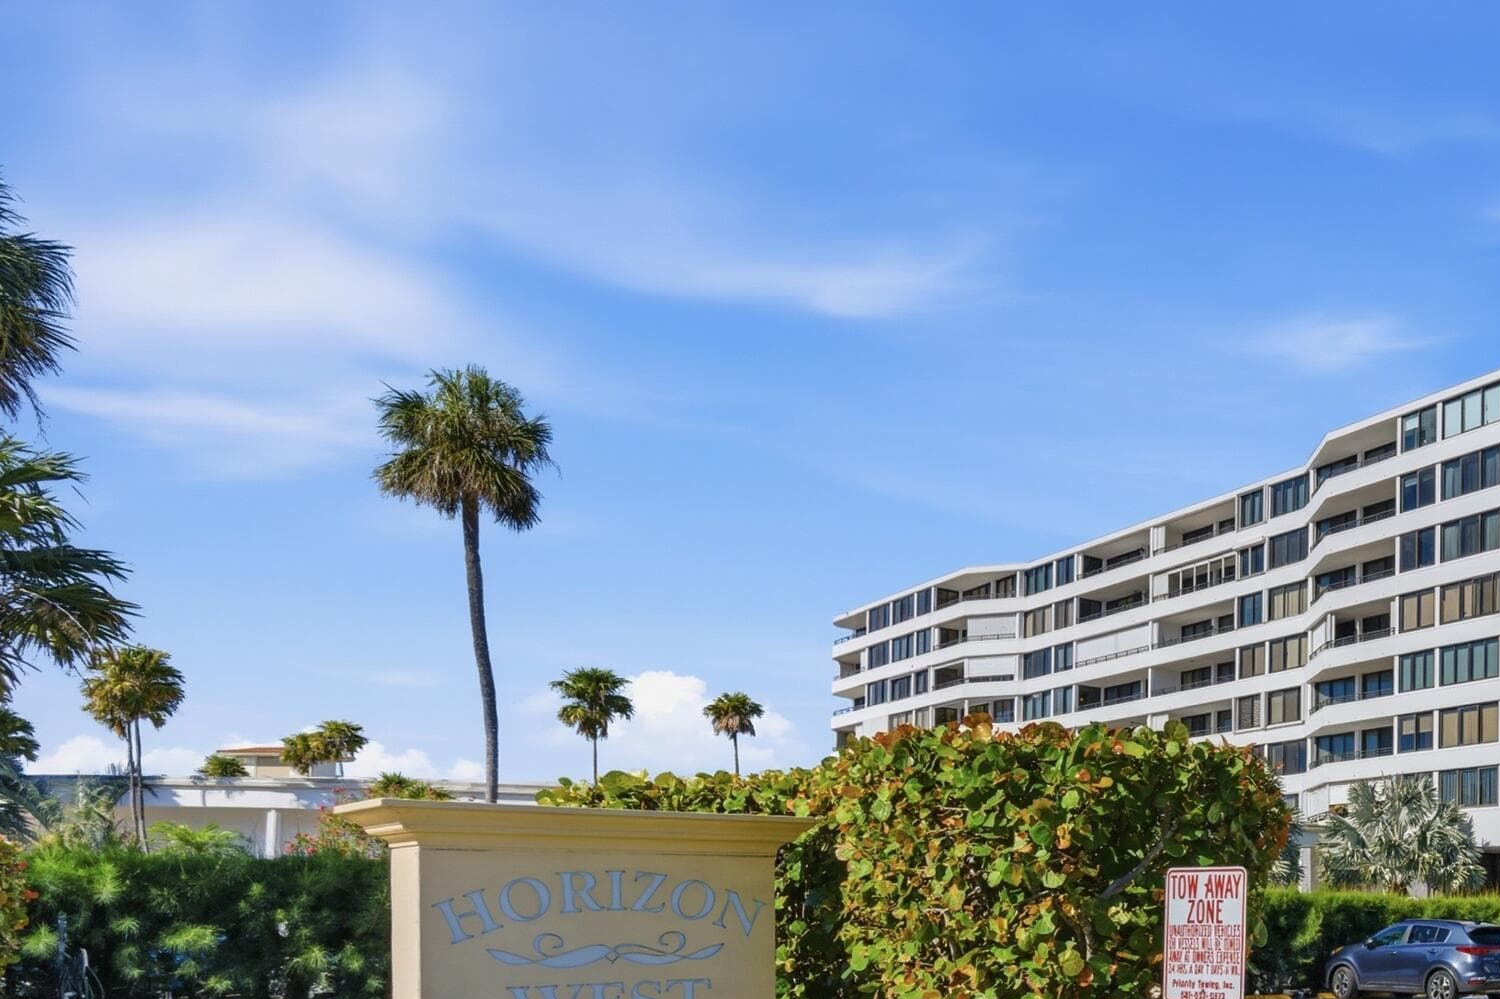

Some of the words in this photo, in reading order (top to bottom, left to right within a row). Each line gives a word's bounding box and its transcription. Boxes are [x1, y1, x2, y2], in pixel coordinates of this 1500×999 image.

[1171, 875, 1198, 899] TOW
[1205, 874, 1241, 899] AWAY
[432, 870, 766, 945] HORIZON
[1187, 899, 1224, 924] ZONE
[1215, 925, 1241, 937] VEHICLES
[1172, 979, 1195, 989] Priority
